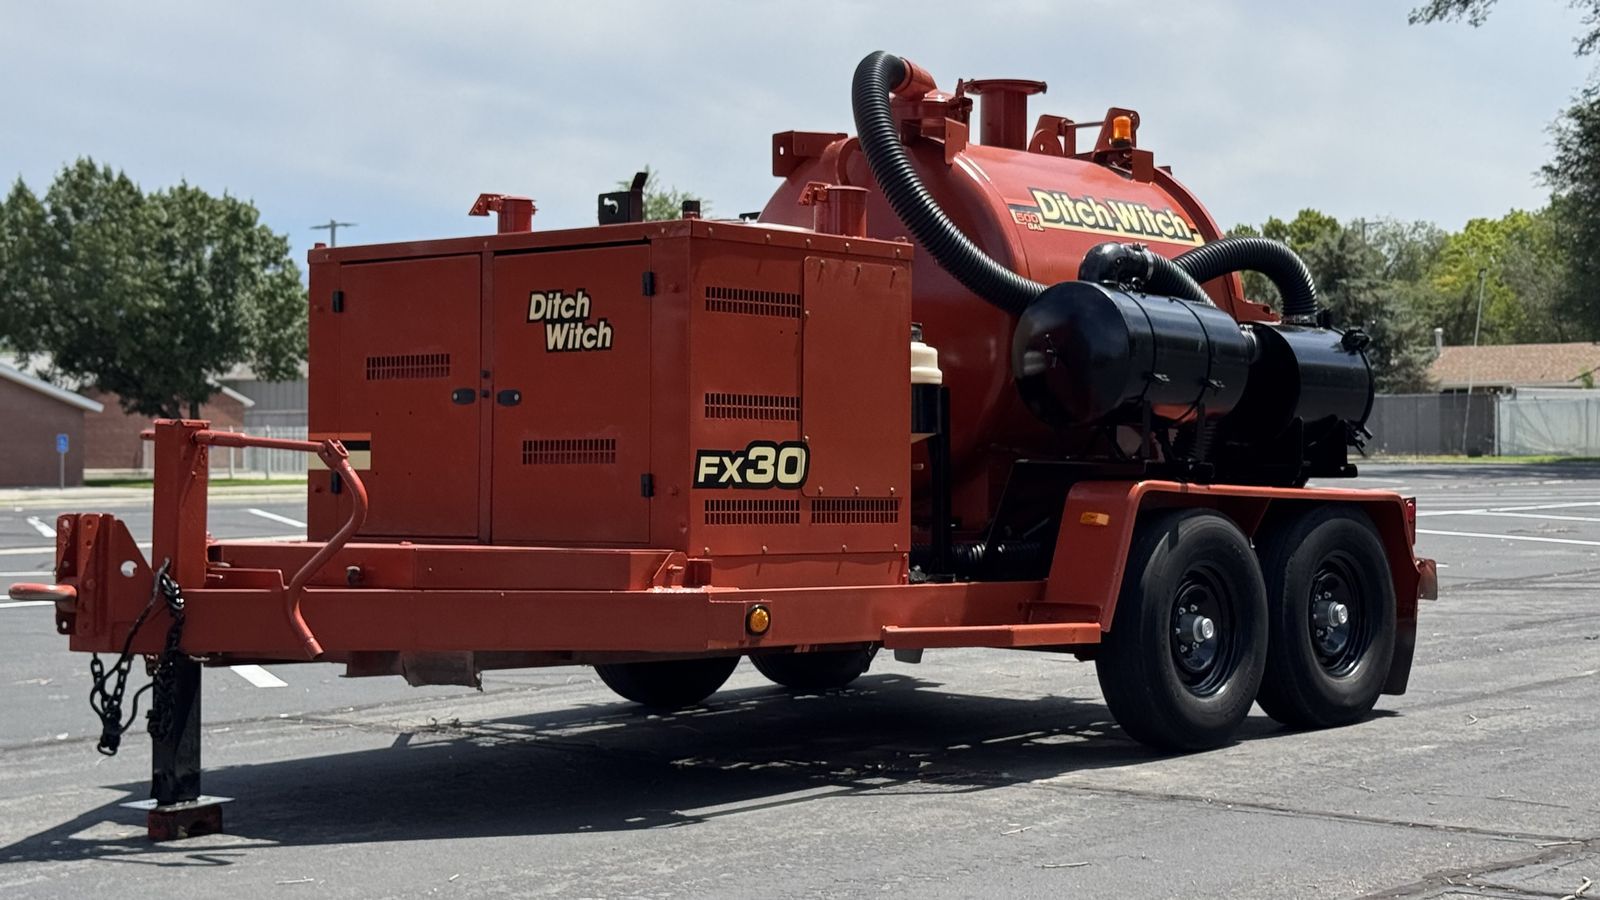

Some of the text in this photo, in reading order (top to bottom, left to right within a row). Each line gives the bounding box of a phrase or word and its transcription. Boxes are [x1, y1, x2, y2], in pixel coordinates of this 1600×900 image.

[1016, 212, 1039, 224] 500
[1027, 222, 1044, 232] GAL
[1031, 189, 1192, 239] Ditch Witch
[528, 290, 590, 321] Ditch
[546, 320, 612, 350] Witch
[697, 445, 807, 484] FX30
